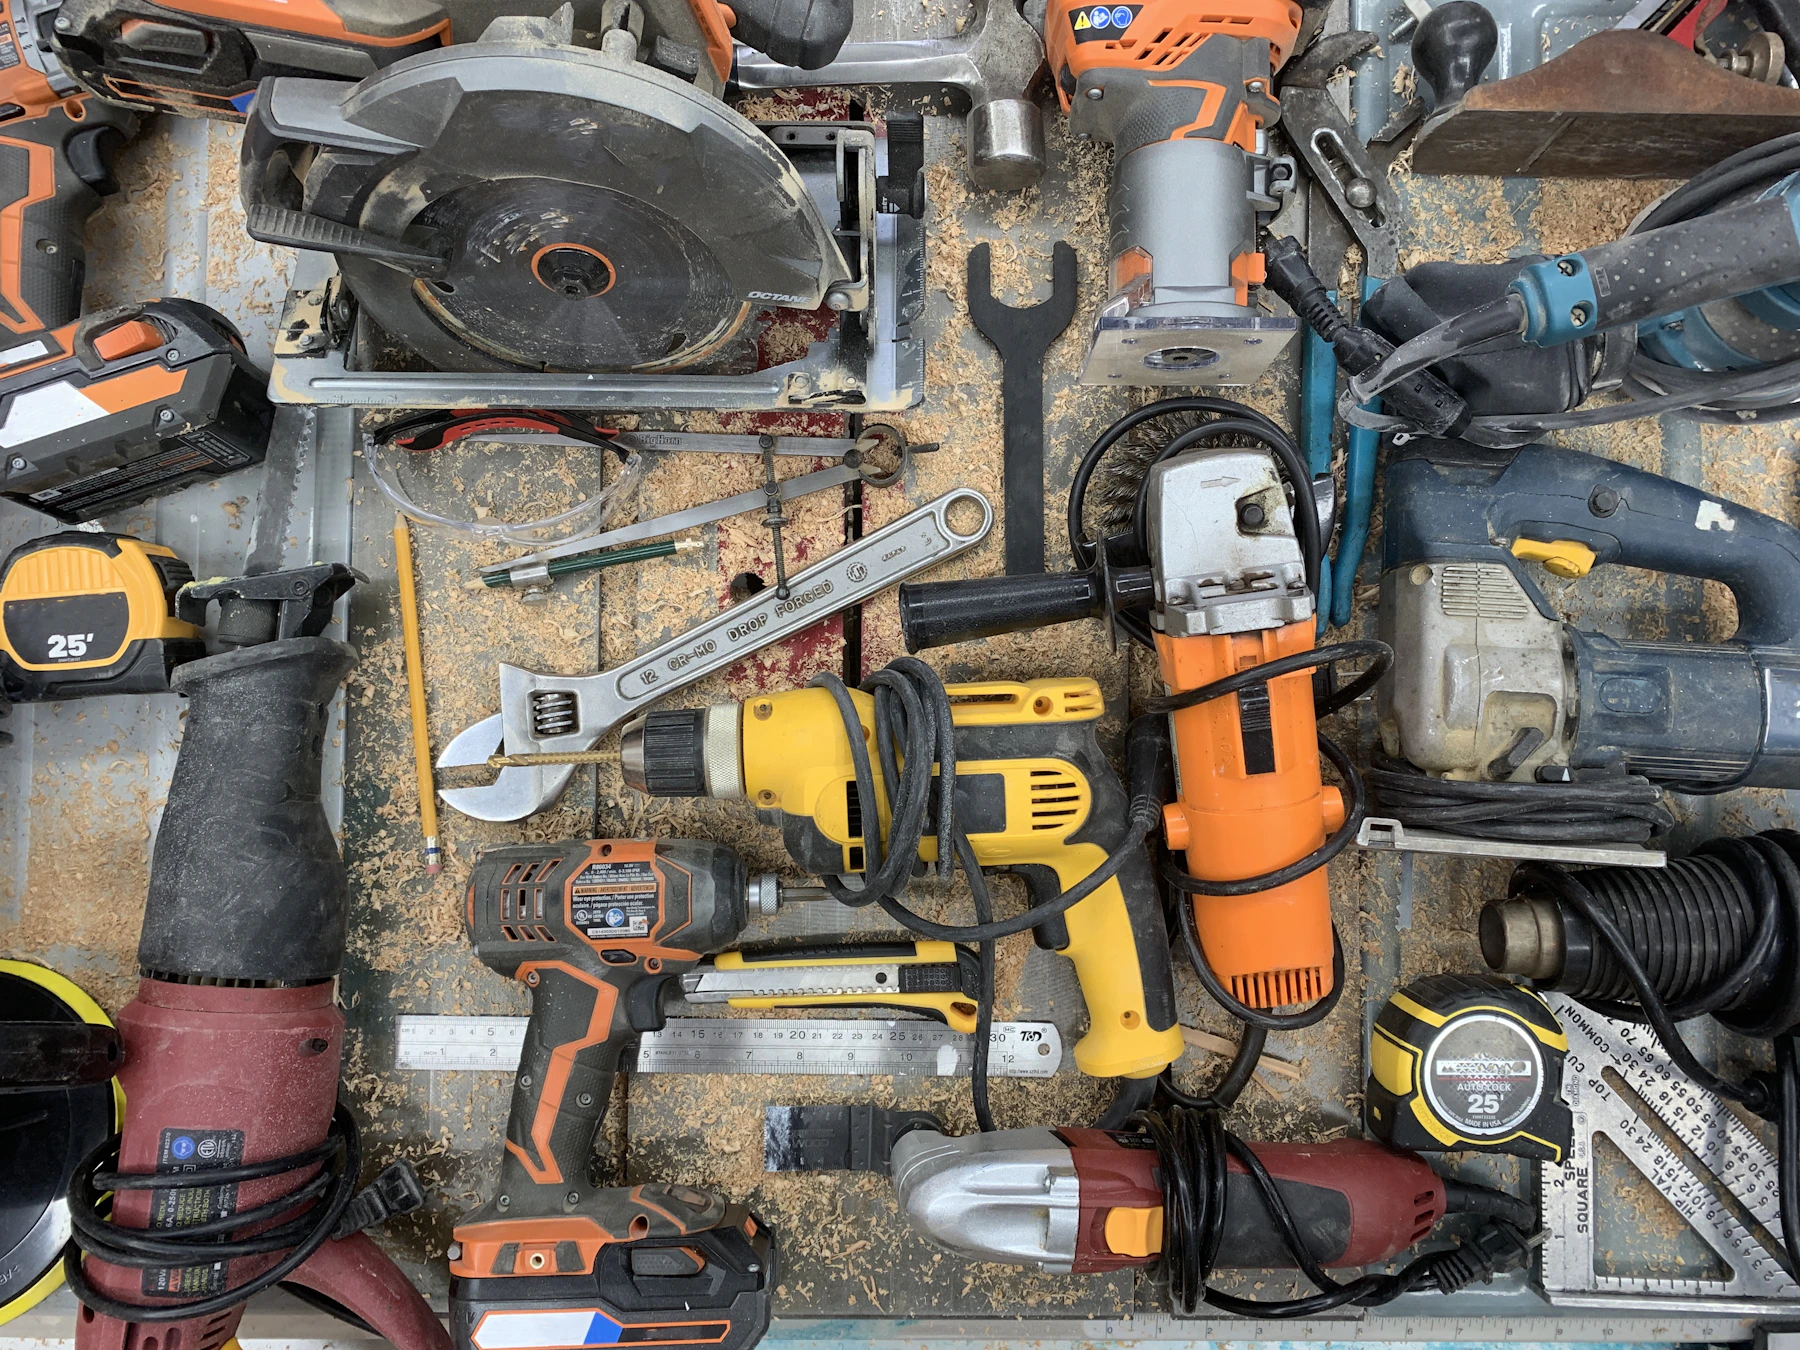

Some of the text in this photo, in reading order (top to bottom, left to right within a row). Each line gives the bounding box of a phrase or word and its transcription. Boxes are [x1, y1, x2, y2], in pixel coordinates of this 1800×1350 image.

[747, 291, 812, 304] OCTANE
[639, 434, 682, 447] BigHorn
[640, 579, 834, 685] 12 CR-MO DROP FORGED
[47, 633, 94, 659] 25'
[487, 1027, 494, 1036] 5
[691, 1029, 705, 1039] 15
[789, 1030, 806, 1039] 20
[889, 1031, 906, 1041] 25
[989, 1033, 1006, 1042] 30
[1564, 1006, 1610, 1053] COMMON
[1620, 1028, 1638, 1046] 70
[489, 1048, 496, 1057] 2
[643, 1050, 650, 1058] 5
[694, 1051, 1015, 1063] 6 7 8 9 10 12
[1638, 1046, 1655, 1064] 65
[1622, 1052, 1639, 1070] 30
[1638, 1069, 1656, 1087] 24
[1654, 1064, 1671, 1081] 60
[1588, 1078, 1612, 1102] TOP
[1670, 1081, 1687, 1099] 55
[1467, 1094, 1504, 1114] 25'
[1659, 1091, 1674, 1106] 18
[1686, 1097, 1703, 1115] 50
[1672, 1106, 1688, 1121] 15
[1701, 1113, 1718, 1129] 45
[1464, 1118, 1481, 1127] MADE
[1490, 1119, 1502, 1127] USA
[1620, 1120, 1637, 1137] 30
[164, 1132, 172, 1147] 62370
[1691, 1124, 1706, 1140] 12
[1716, 1129, 1733, 1145] 40
[1635, 1136, 1653, 1153] 24
[1706, 1141, 1720, 1156] 10
[1731, 1145, 1749, 1164] 35
[1653, 1155, 1668, 1170] 18
[1725, 1160, 1735, 1171] 8
[1665, 1168, 1680, 1182] 15
[1734, 1173, 1745, 1182] 7
[1748, 1162, 1765, 1181] 30
[1554, 1178, 1565, 1188] 2
[1679, 1182, 1694, 1198] 12
[1746, 1183, 1756, 1194] 6
[177, 1194, 186, 1220] REDUCE
[202, 1189, 211, 1210] BOTH
[1577, 1166, 1588, 1234] SQUARE
[1692, 1196, 1706, 1210] 10
[1758, 1196, 1769, 1207] 5
[1705, 1210, 1716, 1220] 8
[1712, 1221, 1724, 1230] 7
[1723, 1229, 1733, 1239] 6
[1732, 1238, 1742, 1249] 5
[1742, 1248, 1751, 1257] 4
[1751, 1259, 1762, 1270] 3
[1763, 1270, 1775, 1281] 2
[1106, 1326, 1113, 1335] 0
[1207, 1327, 1213, 1335] 2
[1257, 1327, 1263, 1335] 3
[1357, 1328, 1363, 1336] 5
[1407, 1328, 1413, 1336] 6
[1457, 1328, 1463, 1336] 7
[1506, 1328, 1513, 1336] 8
[1556, 1328, 1563, 1337] 9
[1602, 1328, 1614, 1337] 10
[1702, 1328, 1713, 1336] 12
